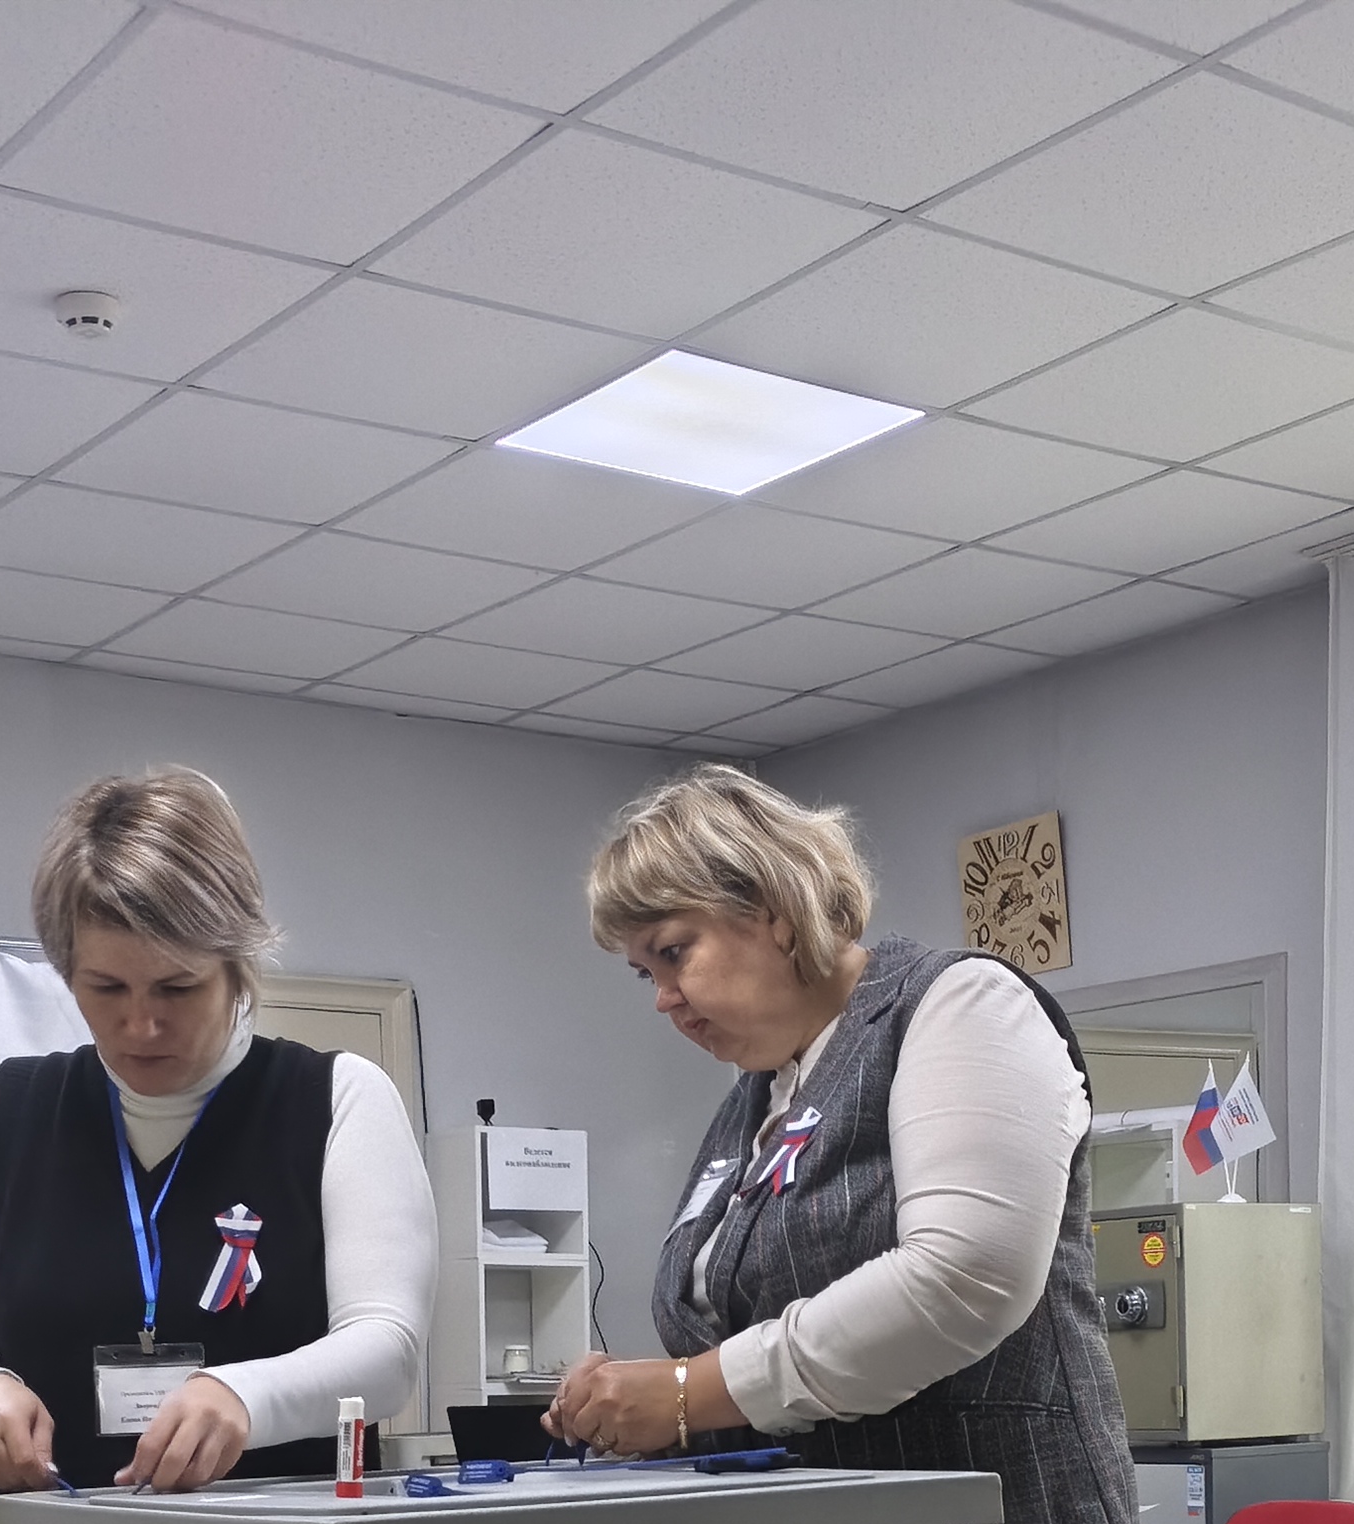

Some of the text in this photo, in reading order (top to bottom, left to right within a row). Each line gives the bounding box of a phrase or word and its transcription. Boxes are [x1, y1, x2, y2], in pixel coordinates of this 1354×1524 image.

[963, 861, 989, 897] 10
[1030, 842, 1056, 880] 2
[1027, 930, 1050, 965] 5
